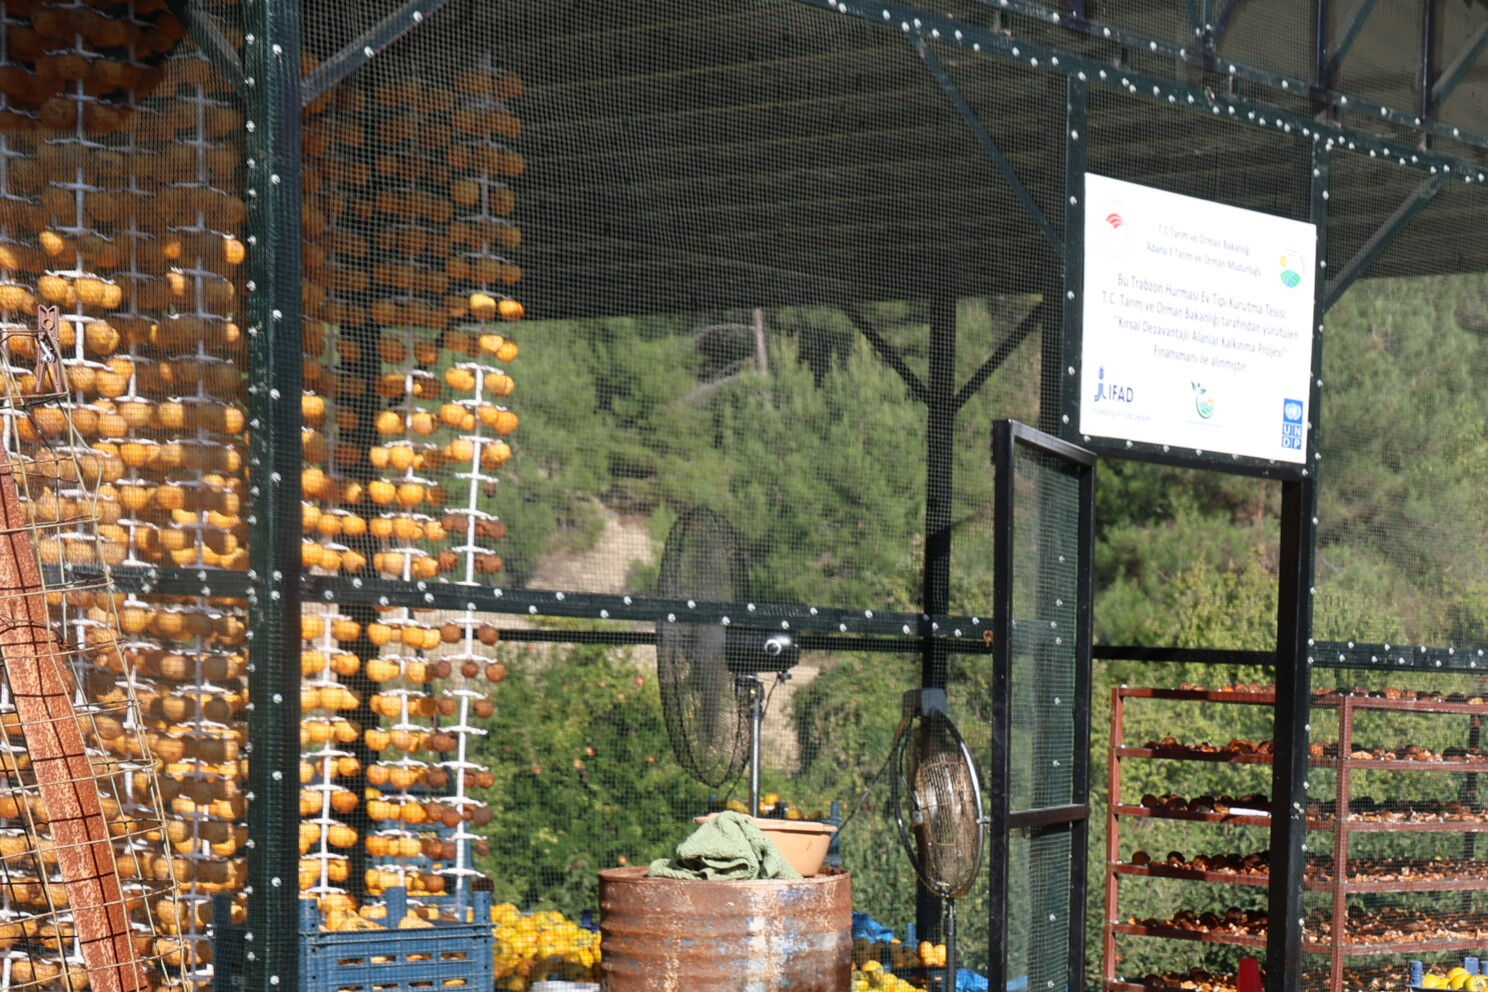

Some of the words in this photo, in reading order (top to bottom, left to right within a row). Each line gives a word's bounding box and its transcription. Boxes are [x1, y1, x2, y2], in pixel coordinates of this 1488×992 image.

[1199, 234, 1222, 247] Orman
[1203, 255, 1226, 268] Orman
[1117, 272, 1129, 287] Bu
[1131, 275, 1163, 293] Trabzon
[1165, 284, 1200, 300] Hurması
[1201, 290, 1210, 304] Ev
[1229, 297, 1263, 315] Kurutma
[1120, 294, 1143, 310] Tarım
[1145, 302, 1155, 312] ve
[1156, 301, 1183, 318] Orman
[1221, 315, 1261, 333] tarafından
[1192, 330, 1219, 346] Alanlar
[1221, 336, 1256, 353] Kalkınma
[1108, 384, 1134, 403] IFAD
